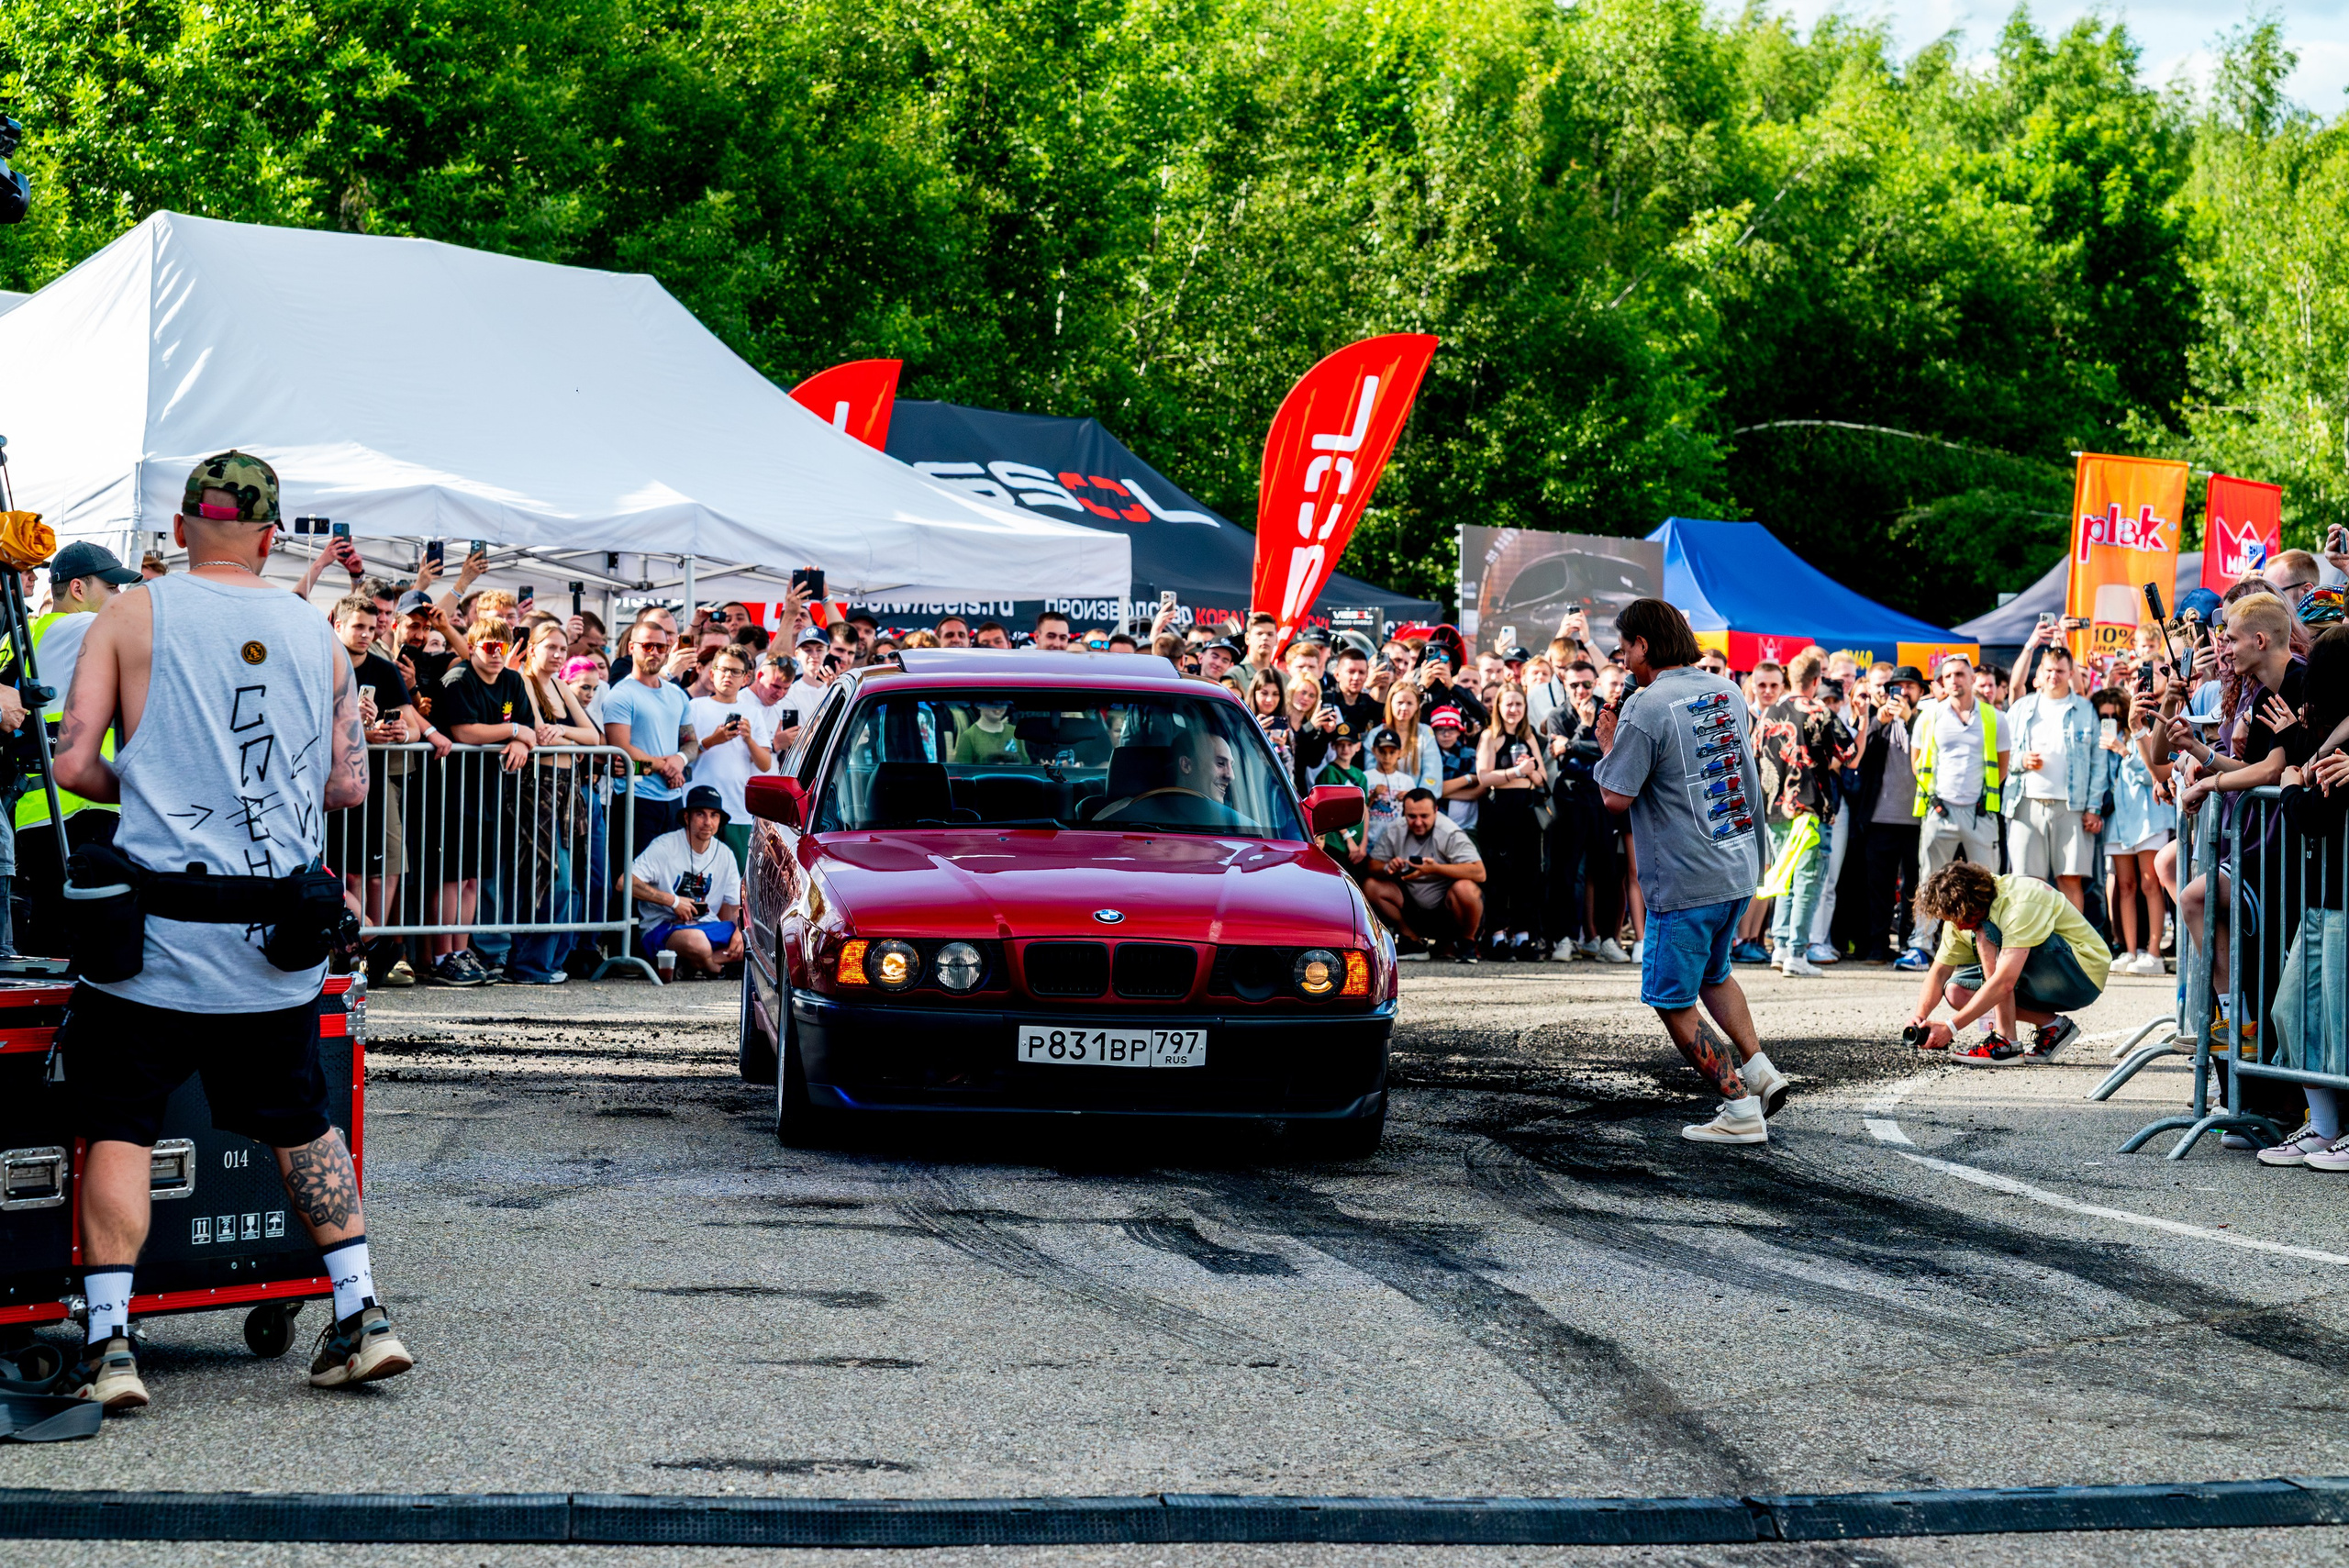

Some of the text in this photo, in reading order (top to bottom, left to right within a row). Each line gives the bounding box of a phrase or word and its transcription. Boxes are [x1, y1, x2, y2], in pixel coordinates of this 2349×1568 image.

[2077, 502, 2170, 564] plak
[1154, 1031, 1199, 1054] 797
[1164, 1056, 1187, 1064] RUS
[224, 1149, 249, 1169] 014
